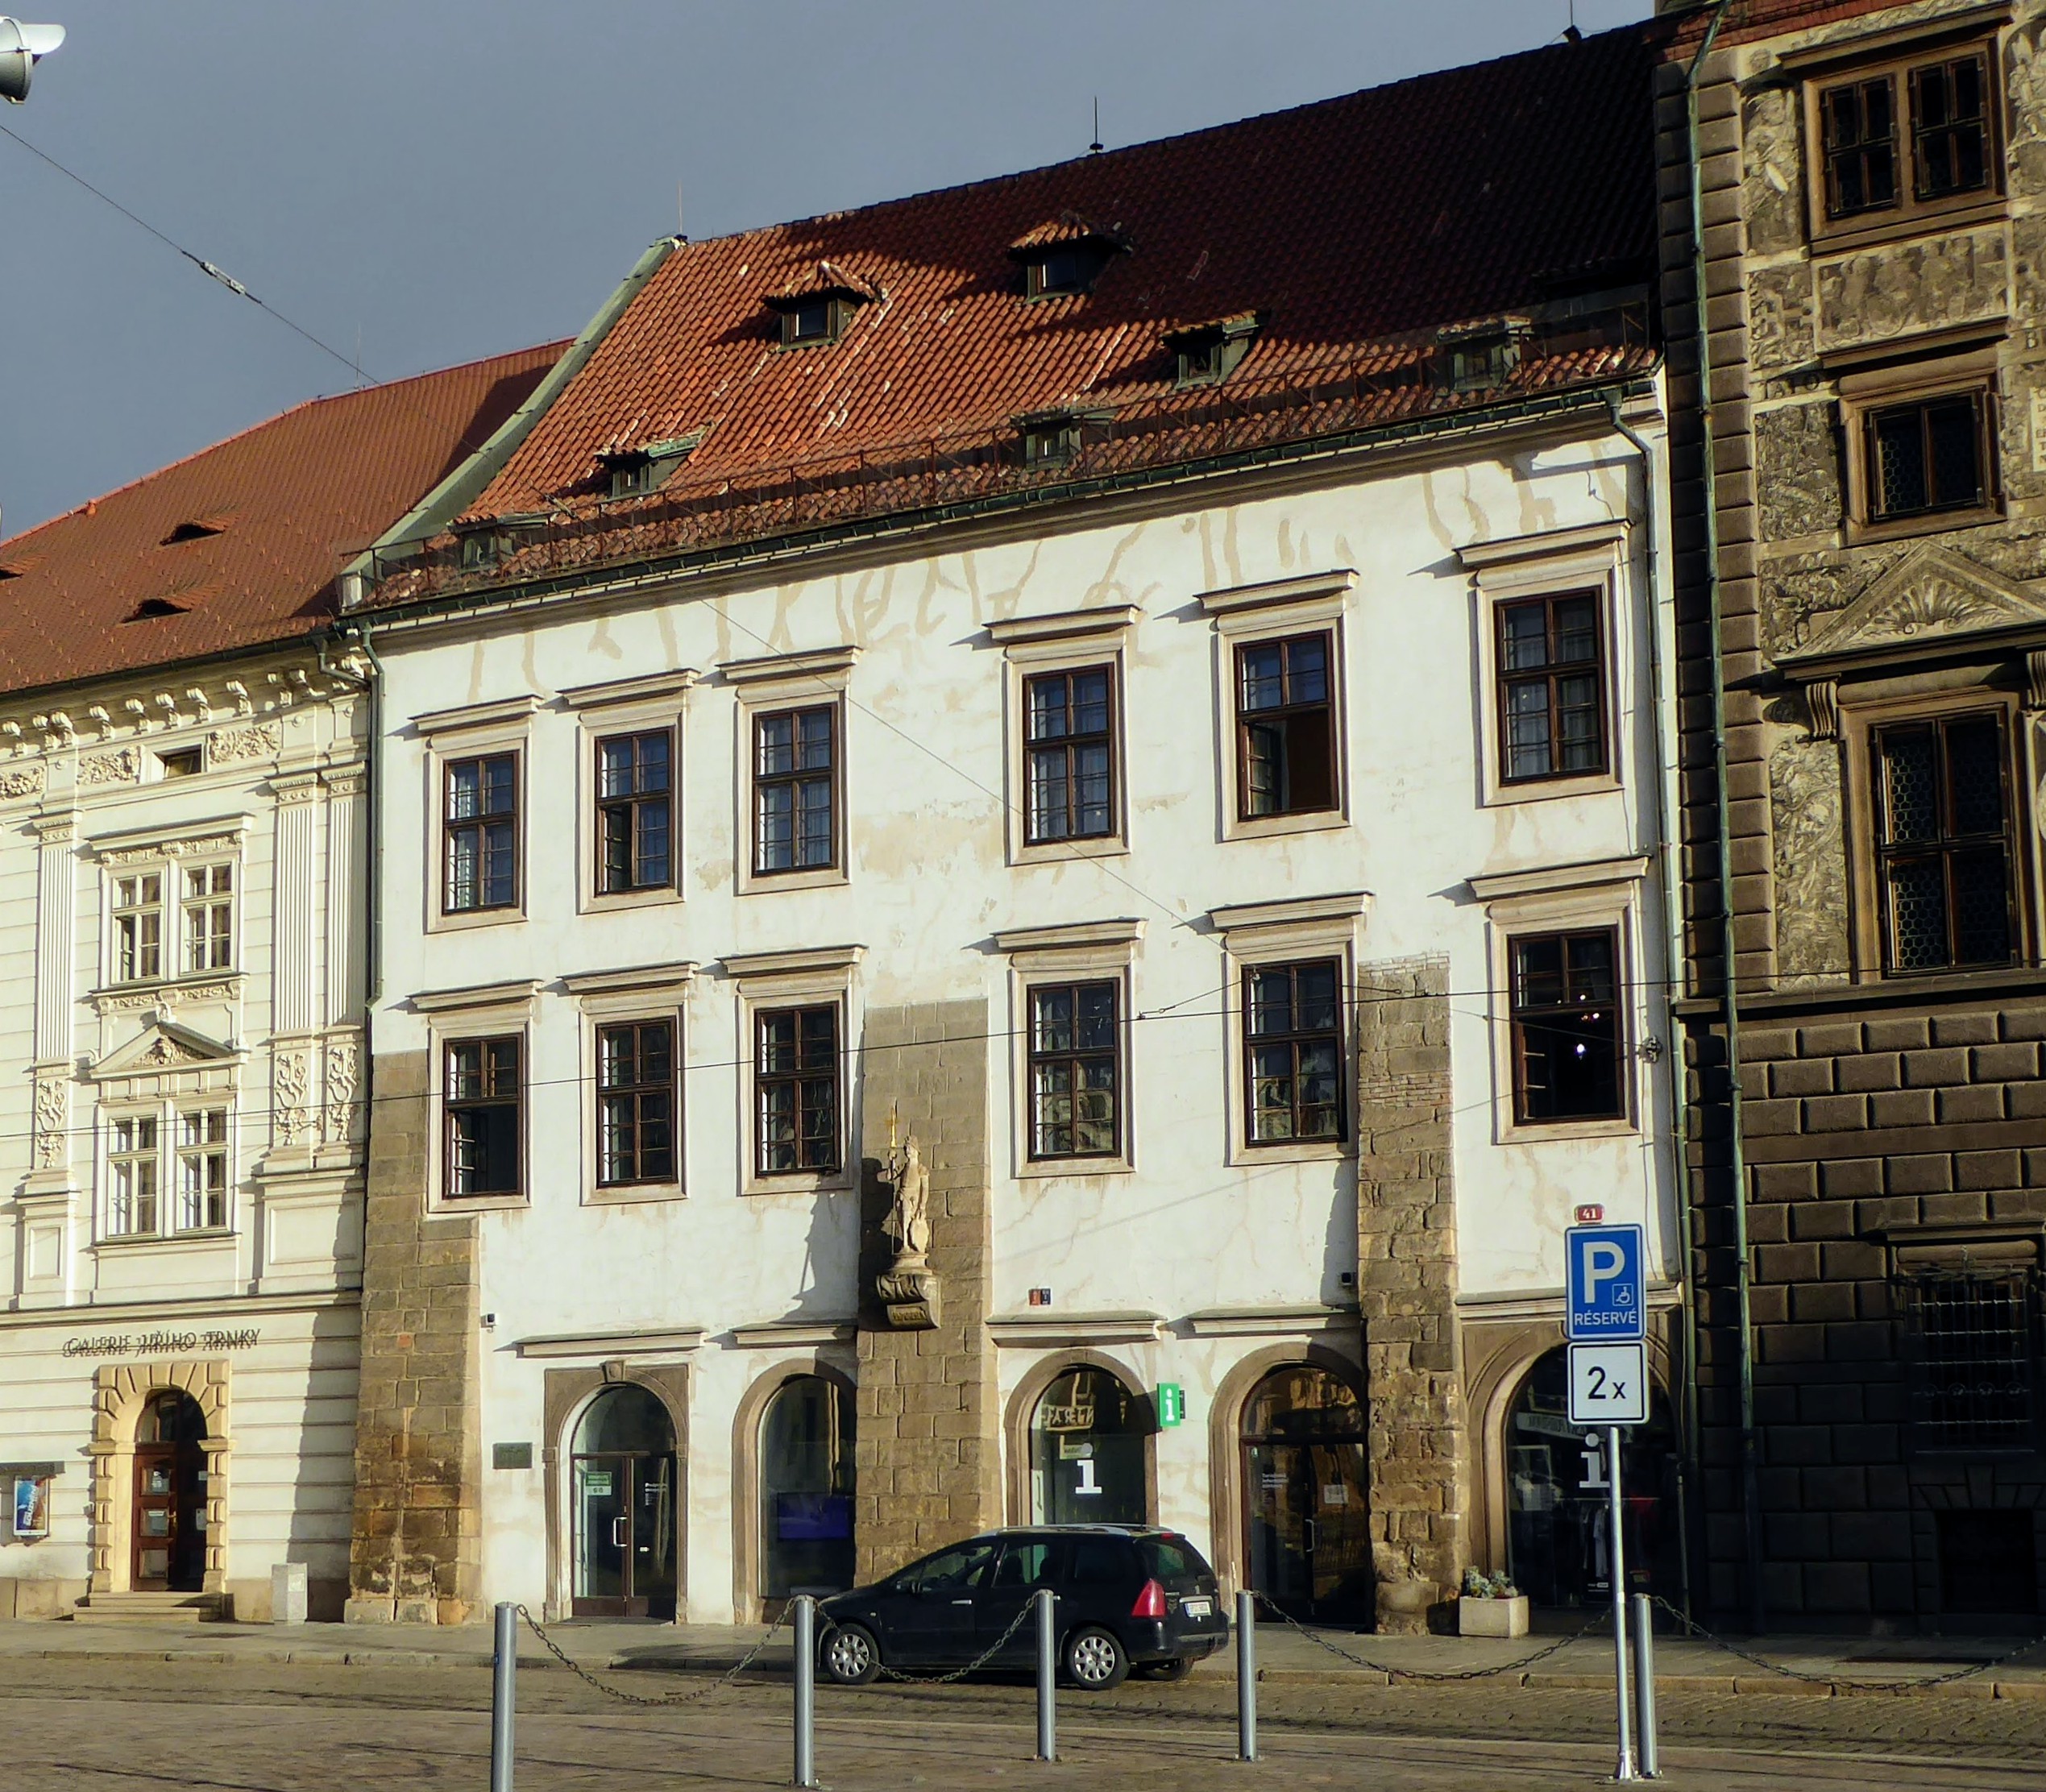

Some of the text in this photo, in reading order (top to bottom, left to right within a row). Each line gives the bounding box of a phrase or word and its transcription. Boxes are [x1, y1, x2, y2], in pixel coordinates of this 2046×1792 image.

[1582, 1209, 1597, 1219] 41
[1583, 1241, 1625, 1304] P
[1574, 1308, 1637, 1326] RÉSERVÉ
[68, 1328, 262, 1354] GALERIE JIŘÍHO TRNKY
